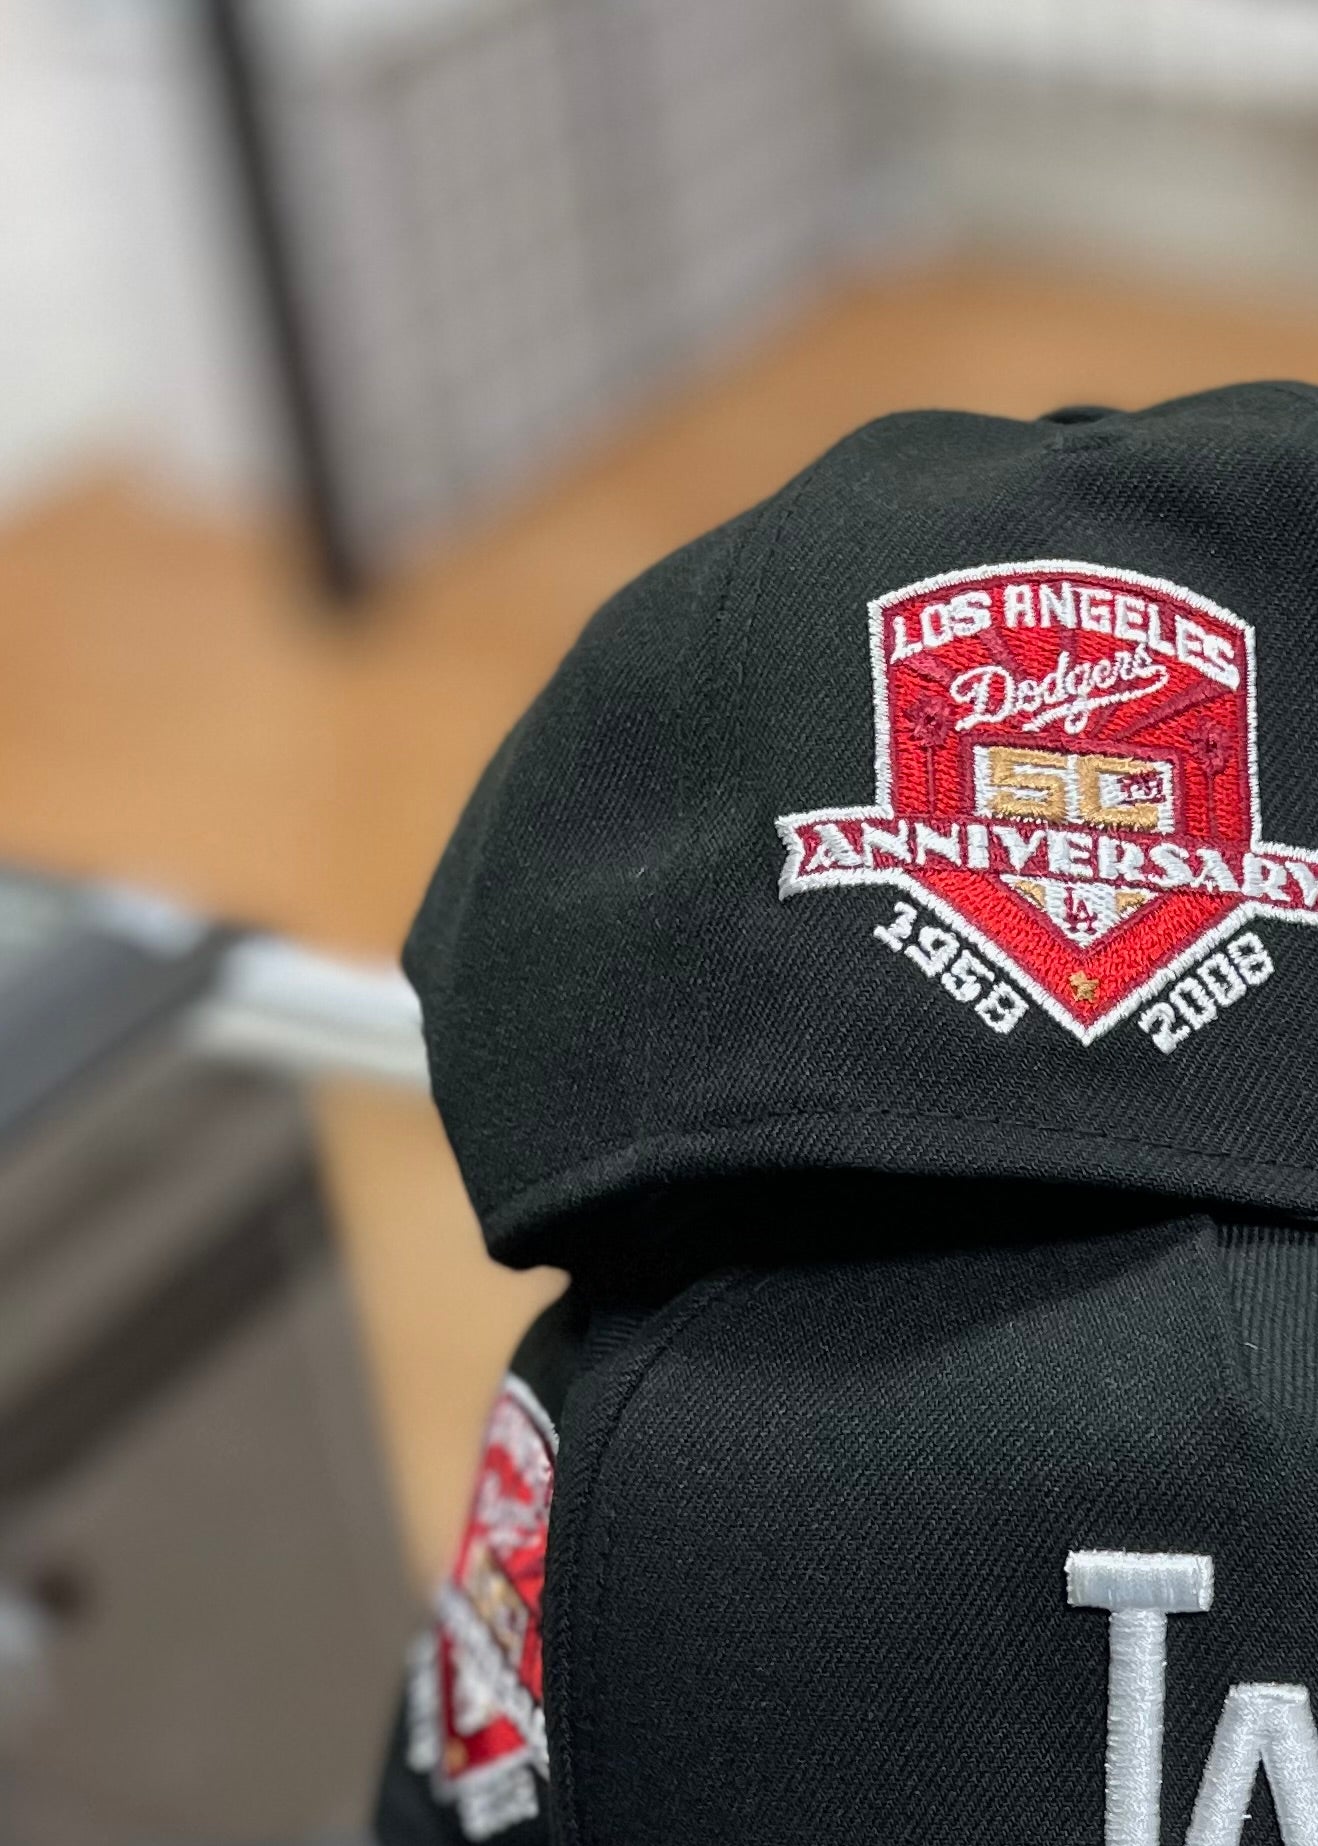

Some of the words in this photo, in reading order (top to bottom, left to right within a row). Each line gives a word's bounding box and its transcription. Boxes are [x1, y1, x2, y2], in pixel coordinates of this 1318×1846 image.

[889, 589, 992, 664] LOS
[1005, 582, 1241, 692] ANGELES
[950, 646, 1169, 734] Dodgers
[1064, 886, 1098, 935] LA
[873, 902, 1029, 1035] 1958
[1137, 931, 1274, 1055] 2008
